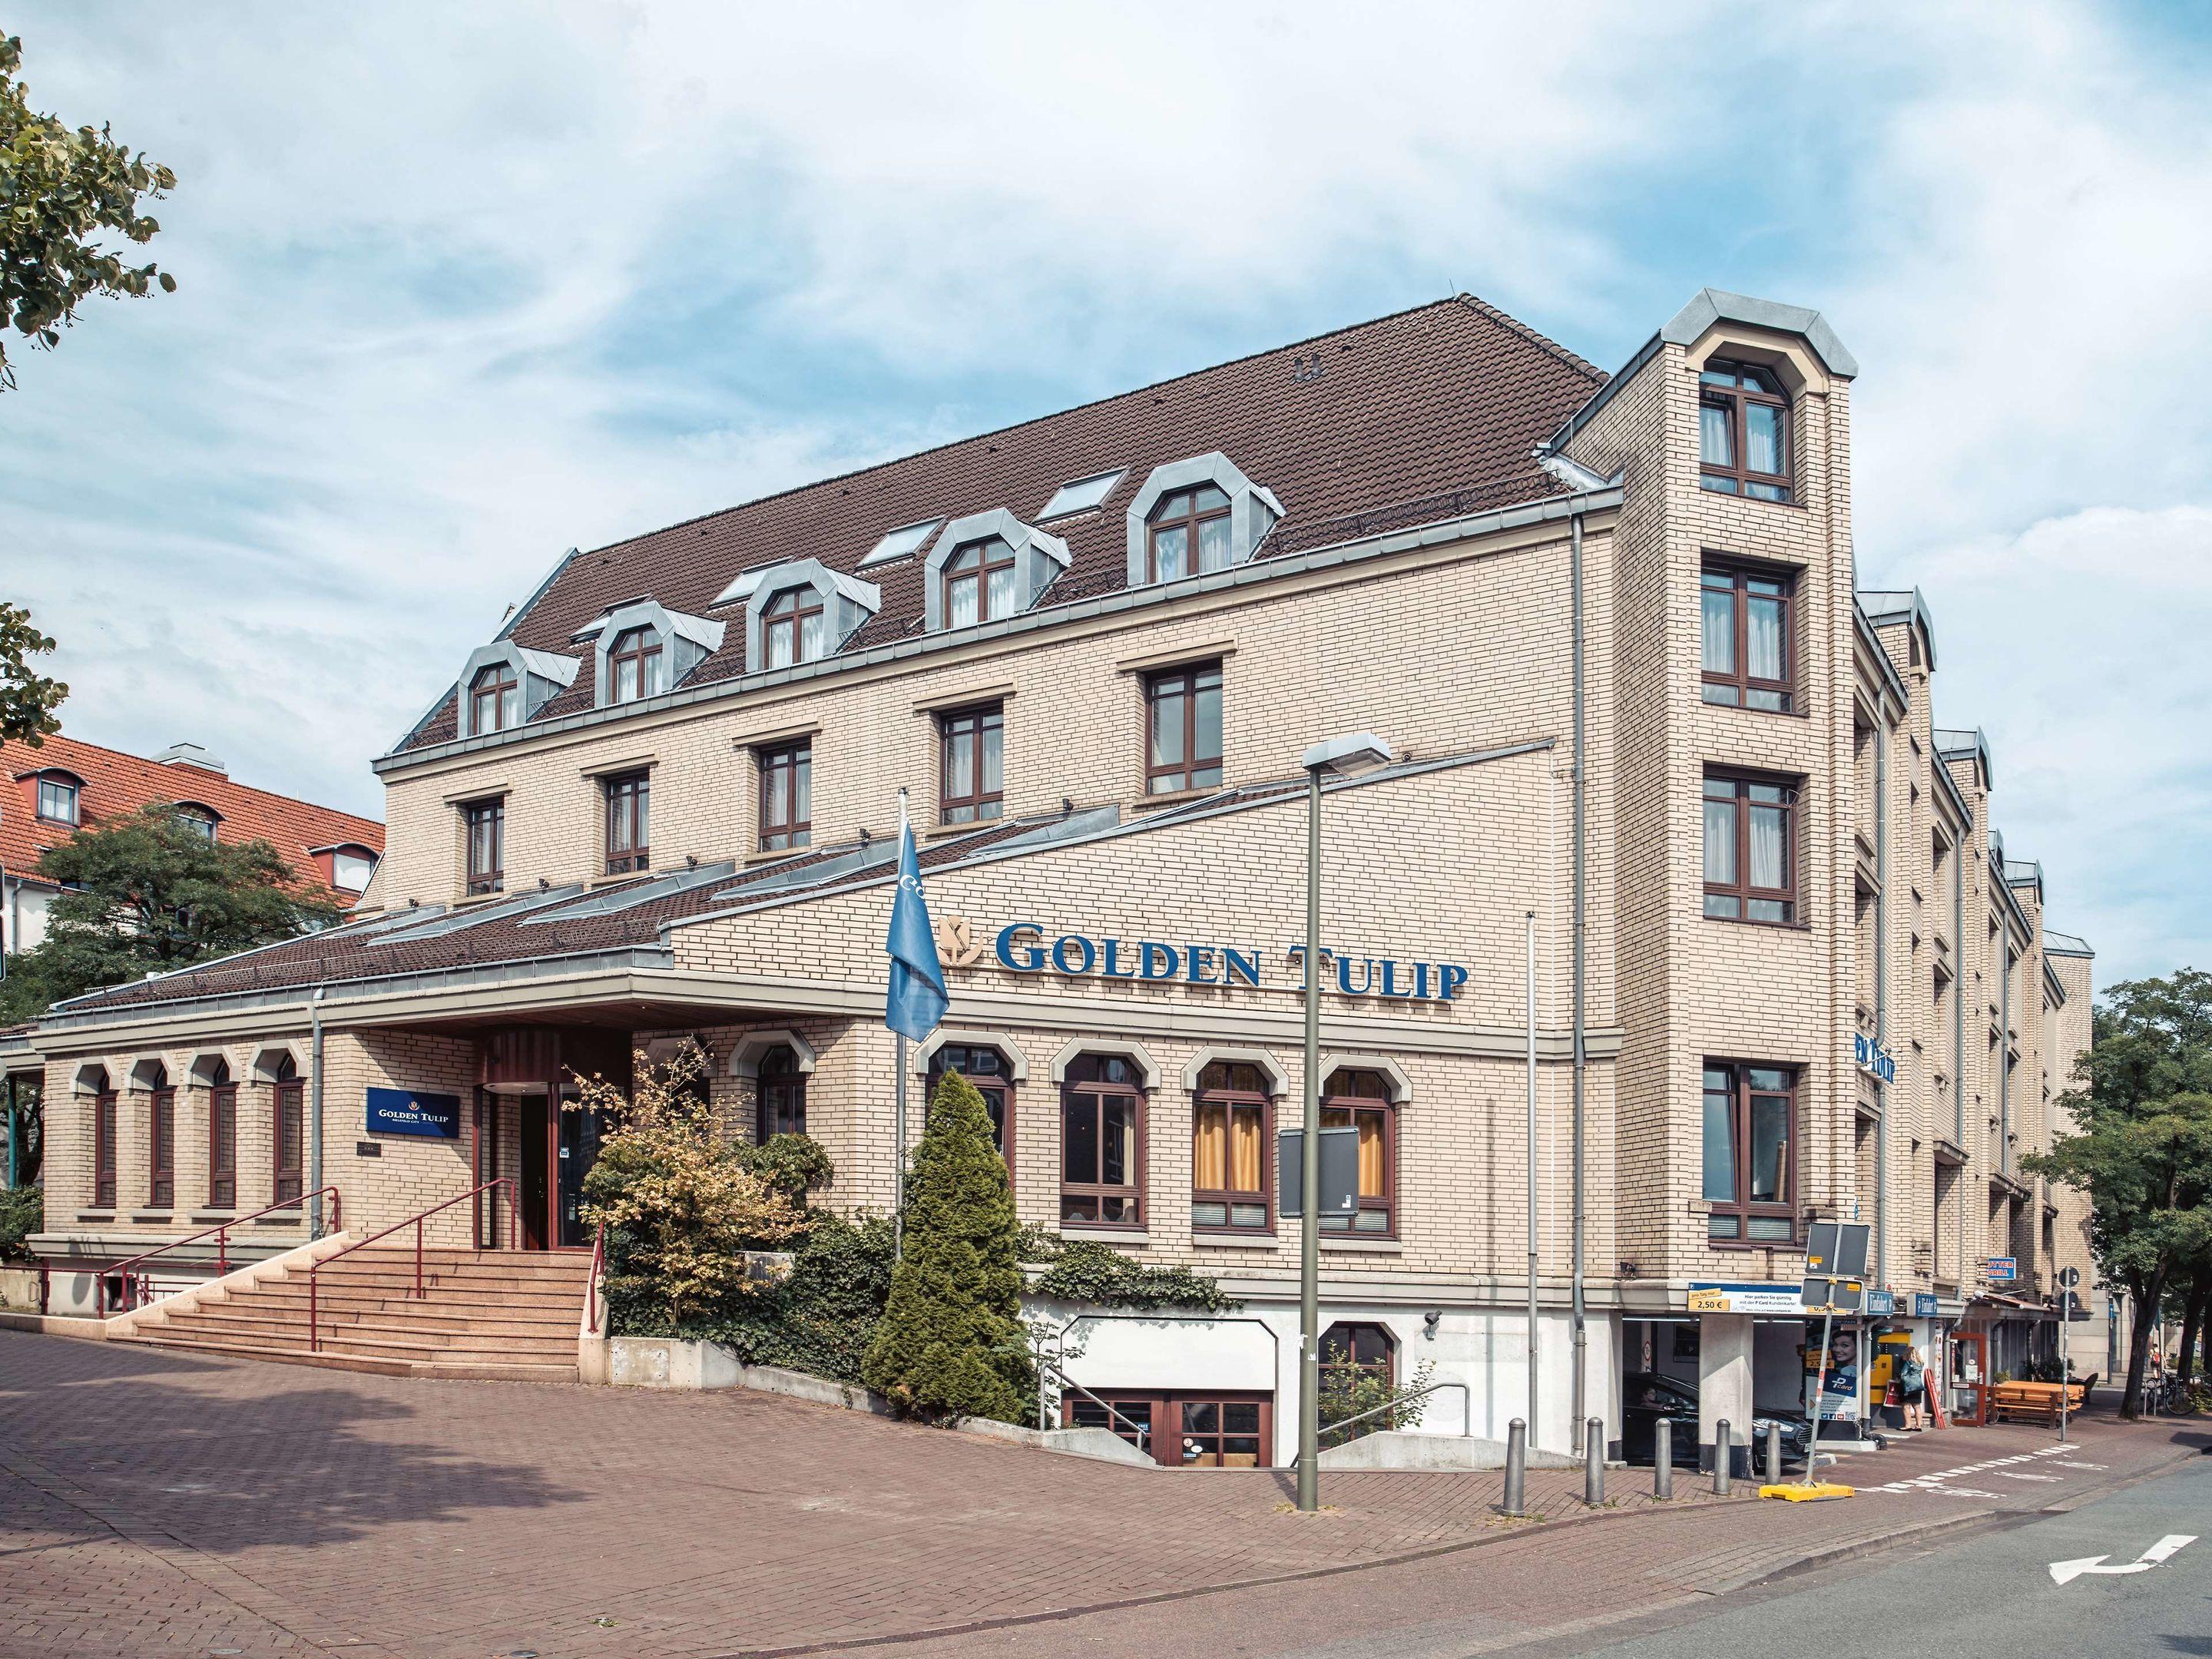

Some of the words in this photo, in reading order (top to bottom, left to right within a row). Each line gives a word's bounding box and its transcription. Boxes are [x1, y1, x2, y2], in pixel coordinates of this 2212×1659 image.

[995, 923, 1262, 987] GOLDEN
[1289, 945, 1469, 1000] TULIP
[379, 1109, 418, 1119] GOLDEN
[421, 1113, 449, 1123] TULIP
[1836, 1383, 1853, 1392] card
